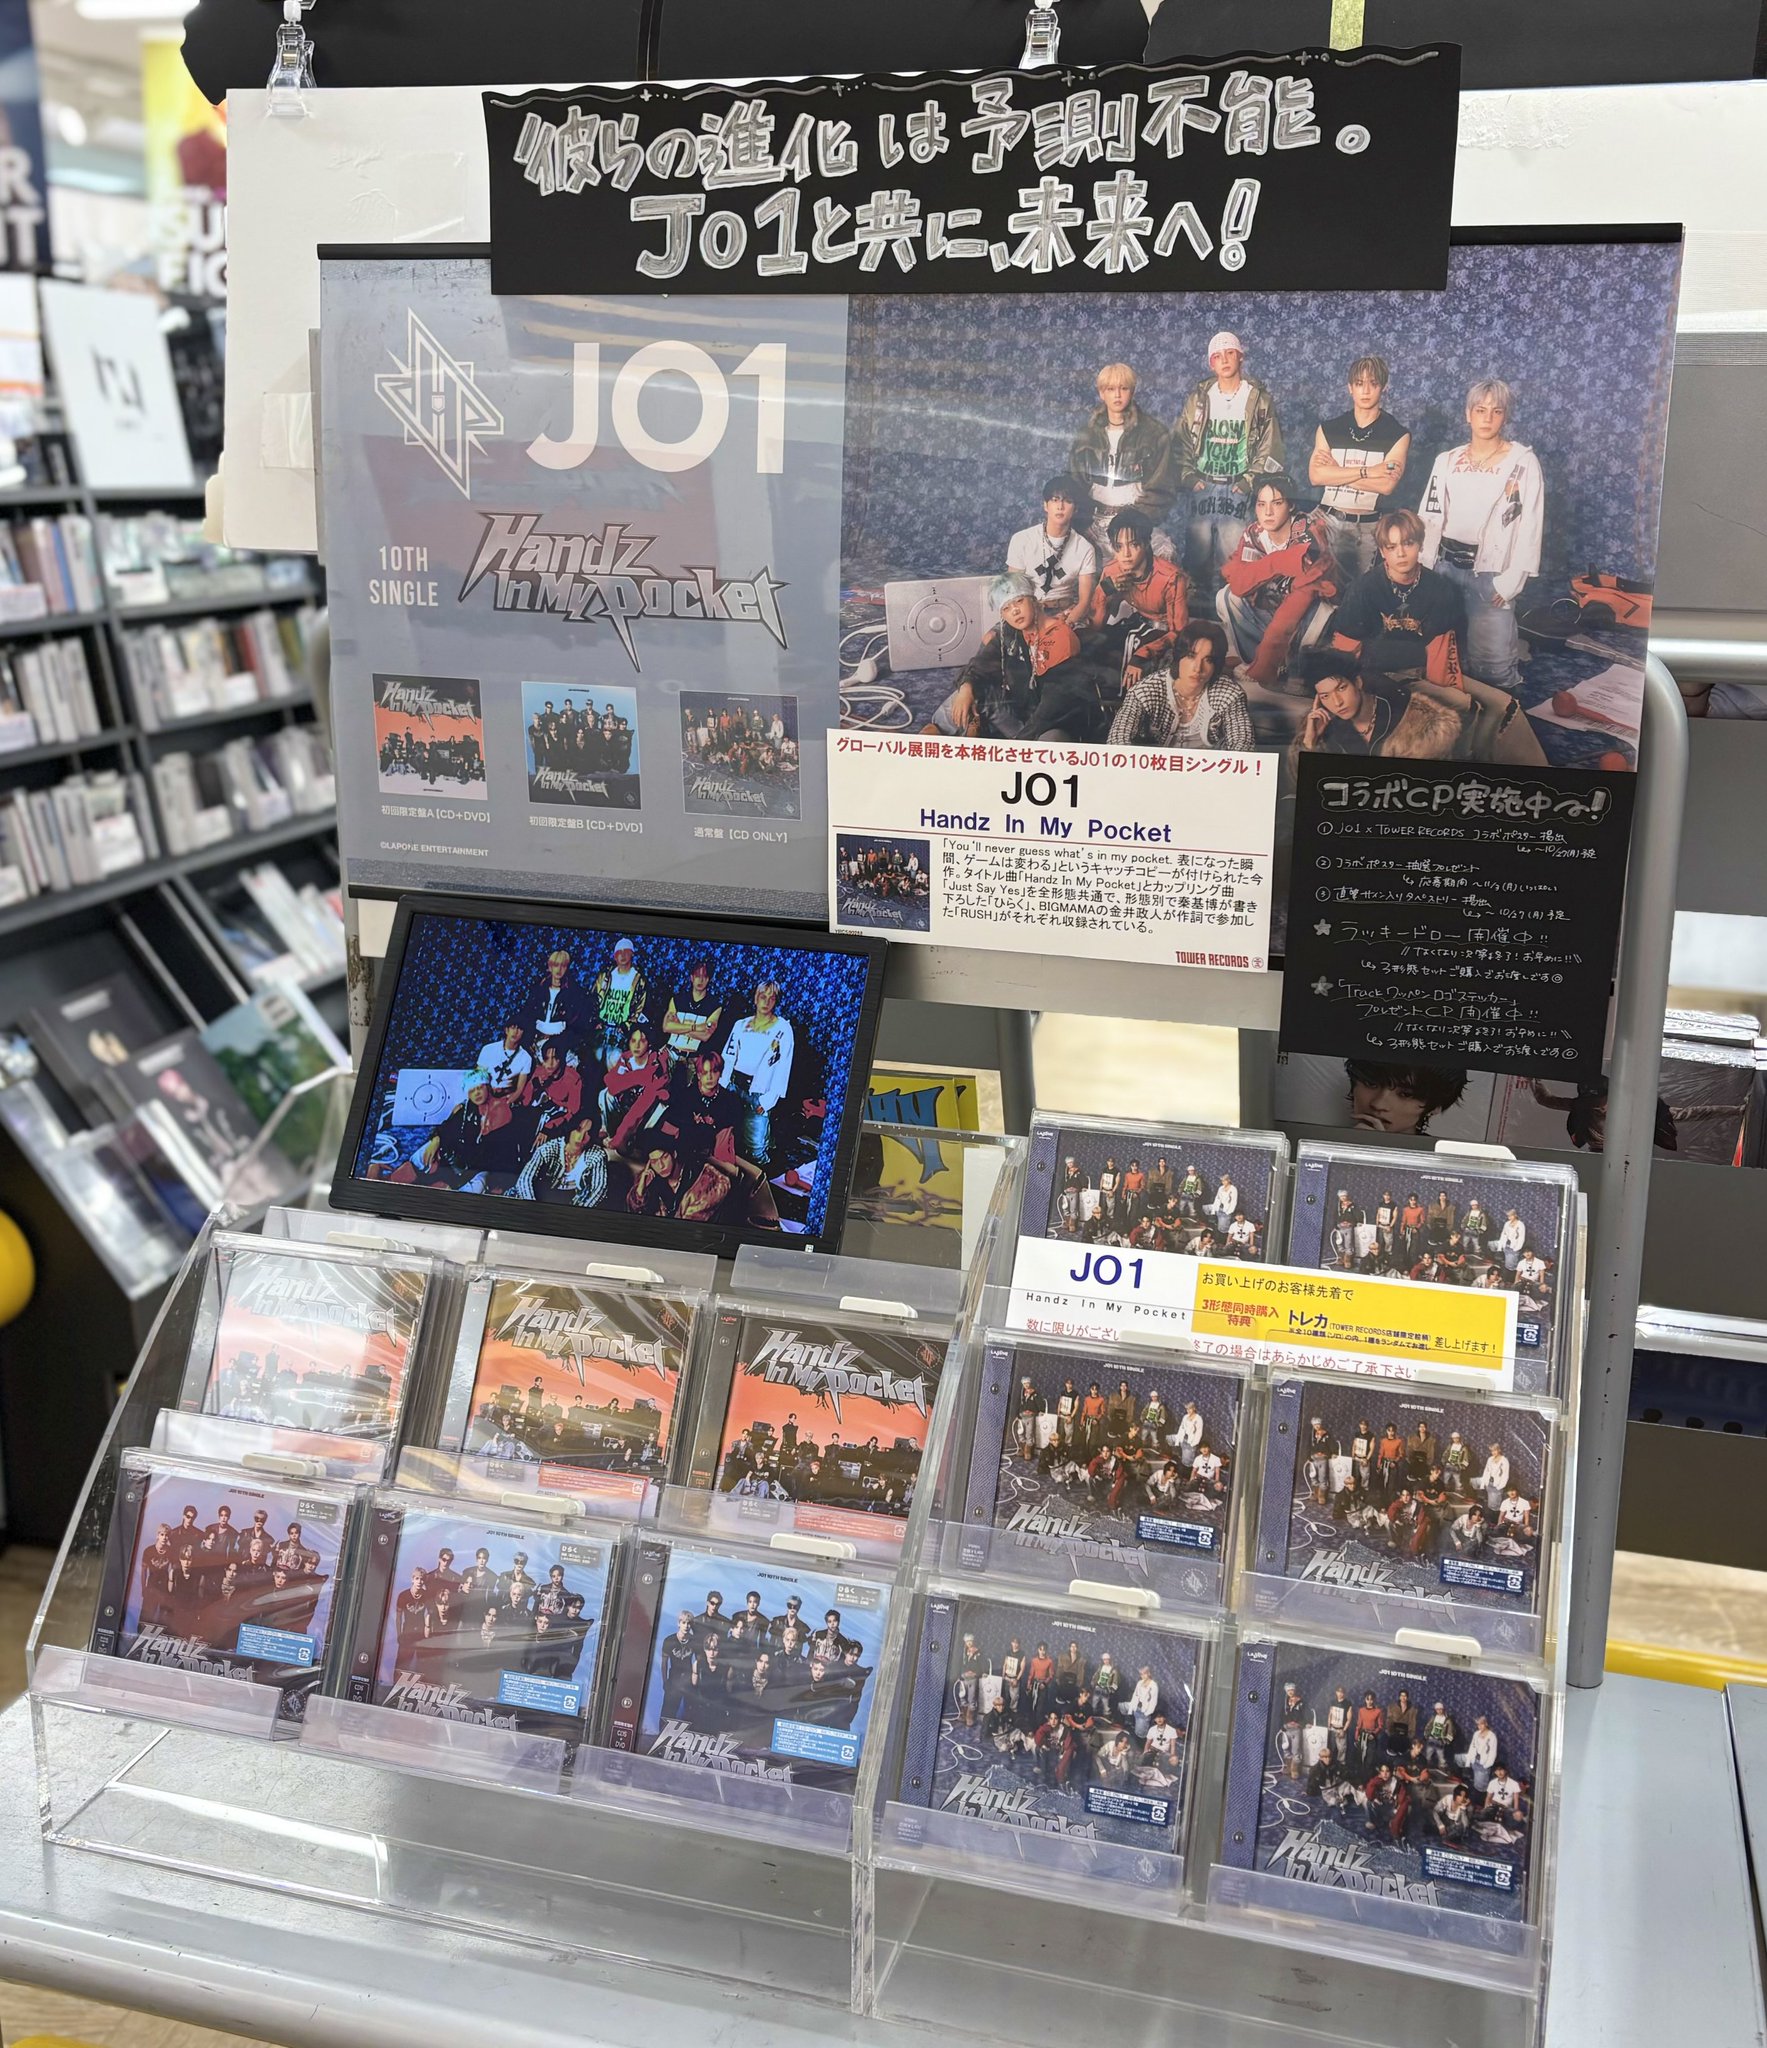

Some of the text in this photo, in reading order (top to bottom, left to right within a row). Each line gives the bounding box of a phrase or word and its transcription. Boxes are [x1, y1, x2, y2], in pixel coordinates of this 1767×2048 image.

[525, 340, 787, 474] JO1
[379, 545, 428, 572] 10TH
[458, 511, 659, 603] Handz
[369, 578, 438, 607] SINGLE
[591, 565, 790, 673] Pocket
[380, 681, 437, 706] Handz
[1001, 771, 1080, 808] JO1
[920, 809, 1172, 844] Handz In My Pocket
[1376, 823, 1415, 836] TOWER
[1418, 825, 1465, 838] RECORDS
[421, 844, 489, 857] ENTERTAINMENT
[984, 844, 1014, 854] never
[1019, 848, 1050, 857] guess
[1097, 849, 1107, 861] in
[1111, 852, 1127, 864] my
[976, 882, 995, 895] Say
[1062, 875, 1073, 886] In
[1076, 876, 1093, 888] My
[1176, 951, 1249, 969] TOWER RECORDS
[239, 1264, 344, 1304] Handz
[1070, 1252, 1143, 1289] JO1
[1202, 1271, 1354, 1301] お買い上げのお客様先着で
[494, 1294, 608, 1340] Handz
[1026, 1292, 1186, 1320] Handz In My Pocket
[1202, 1299, 1279, 1319] 3形態同時購入
[1227, 1314, 1251, 1328] 特典
[1288, 1309, 1328, 1329] トレカ
[563, 1331, 670, 1387] Pocket
[746, 1327, 864, 1376] Handz
[1434, 1336, 1496, 1354] 差し上げます!
[763, 1358, 933, 1424] In My Pocket
[1005, 1501, 1096, 1540] Handz
[1301, 1548, 1399, 1589] Handz
[126, 1623, 211, 1659] Handz
[382, 1670, 472, 1709] Handz
[646, 1717, 743, 1760] Handz
[939, 1771, 1045, 1816] Handz
[1266, 1827, 1382, 1873] Handz
[1339, 1869, 1447, 1917] Pocket
